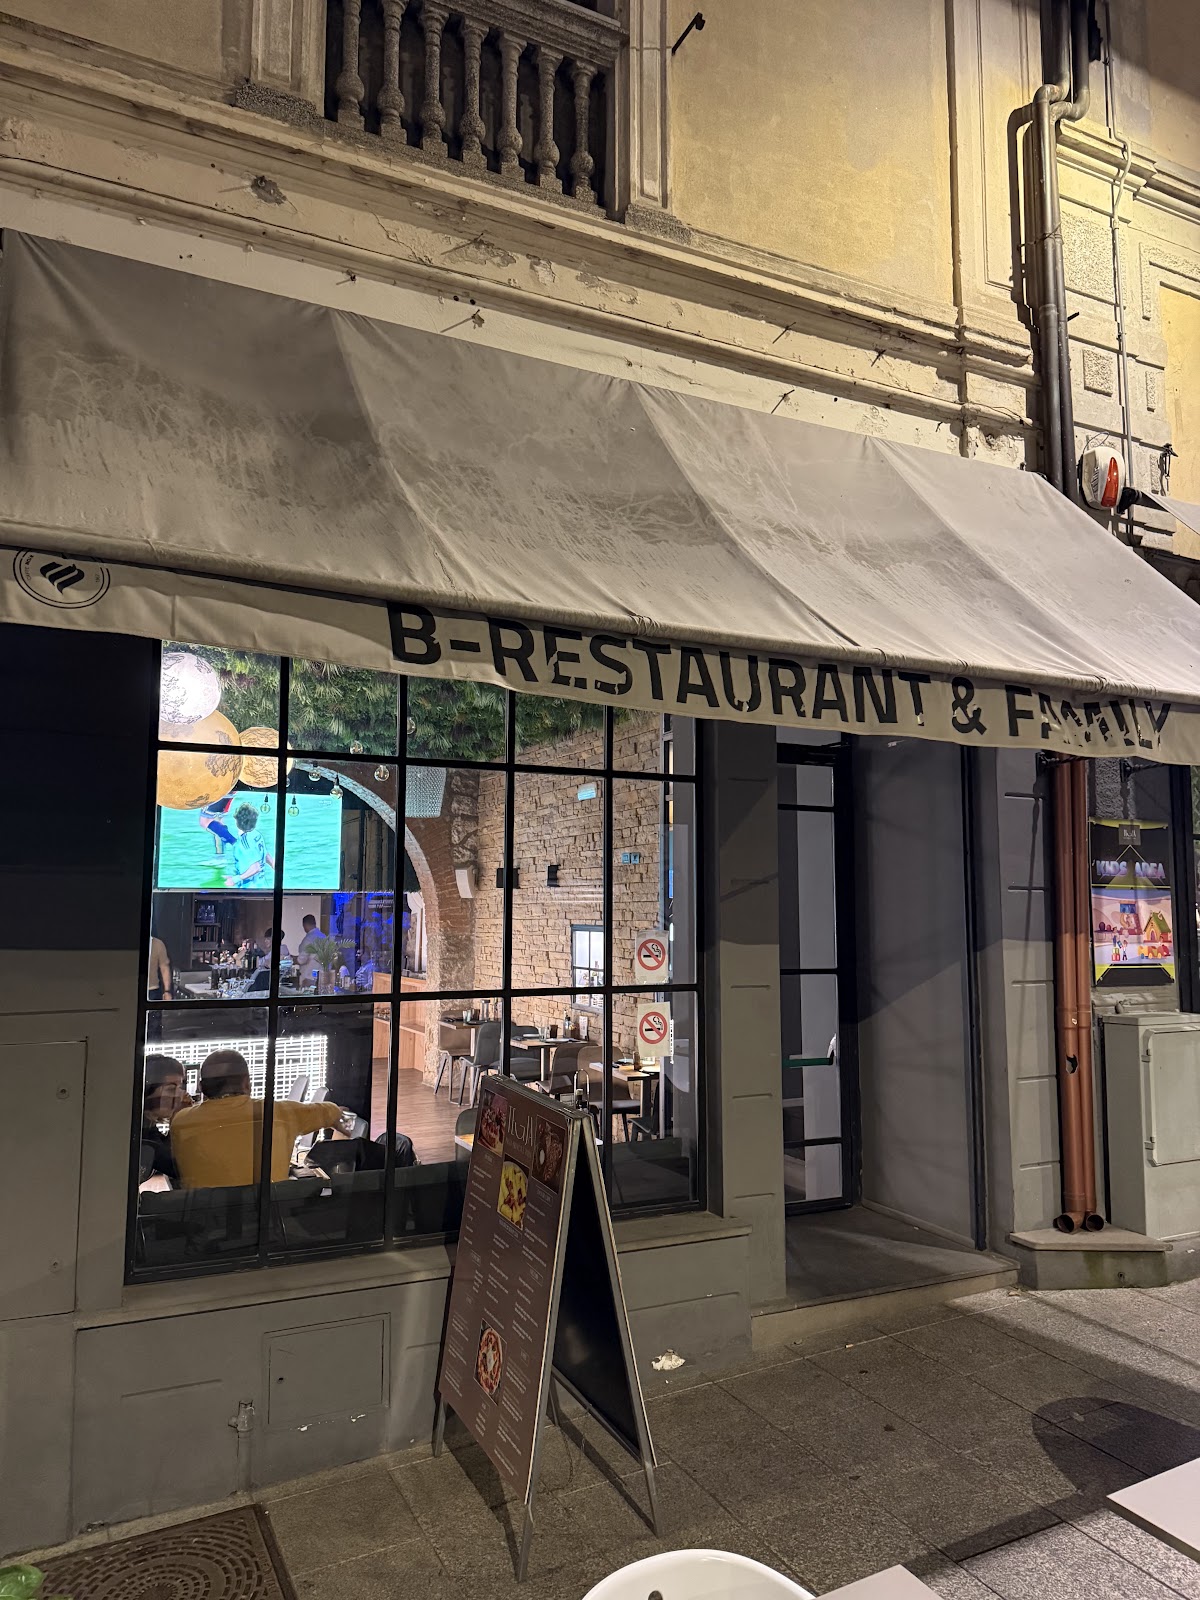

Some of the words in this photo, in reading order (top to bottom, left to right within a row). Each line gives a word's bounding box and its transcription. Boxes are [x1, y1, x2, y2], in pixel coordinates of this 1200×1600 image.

[951, 676, 988, 736] &
[1096, 860, 1128, 877] KIDS
[1134, 862, 1166, 880] AREA
